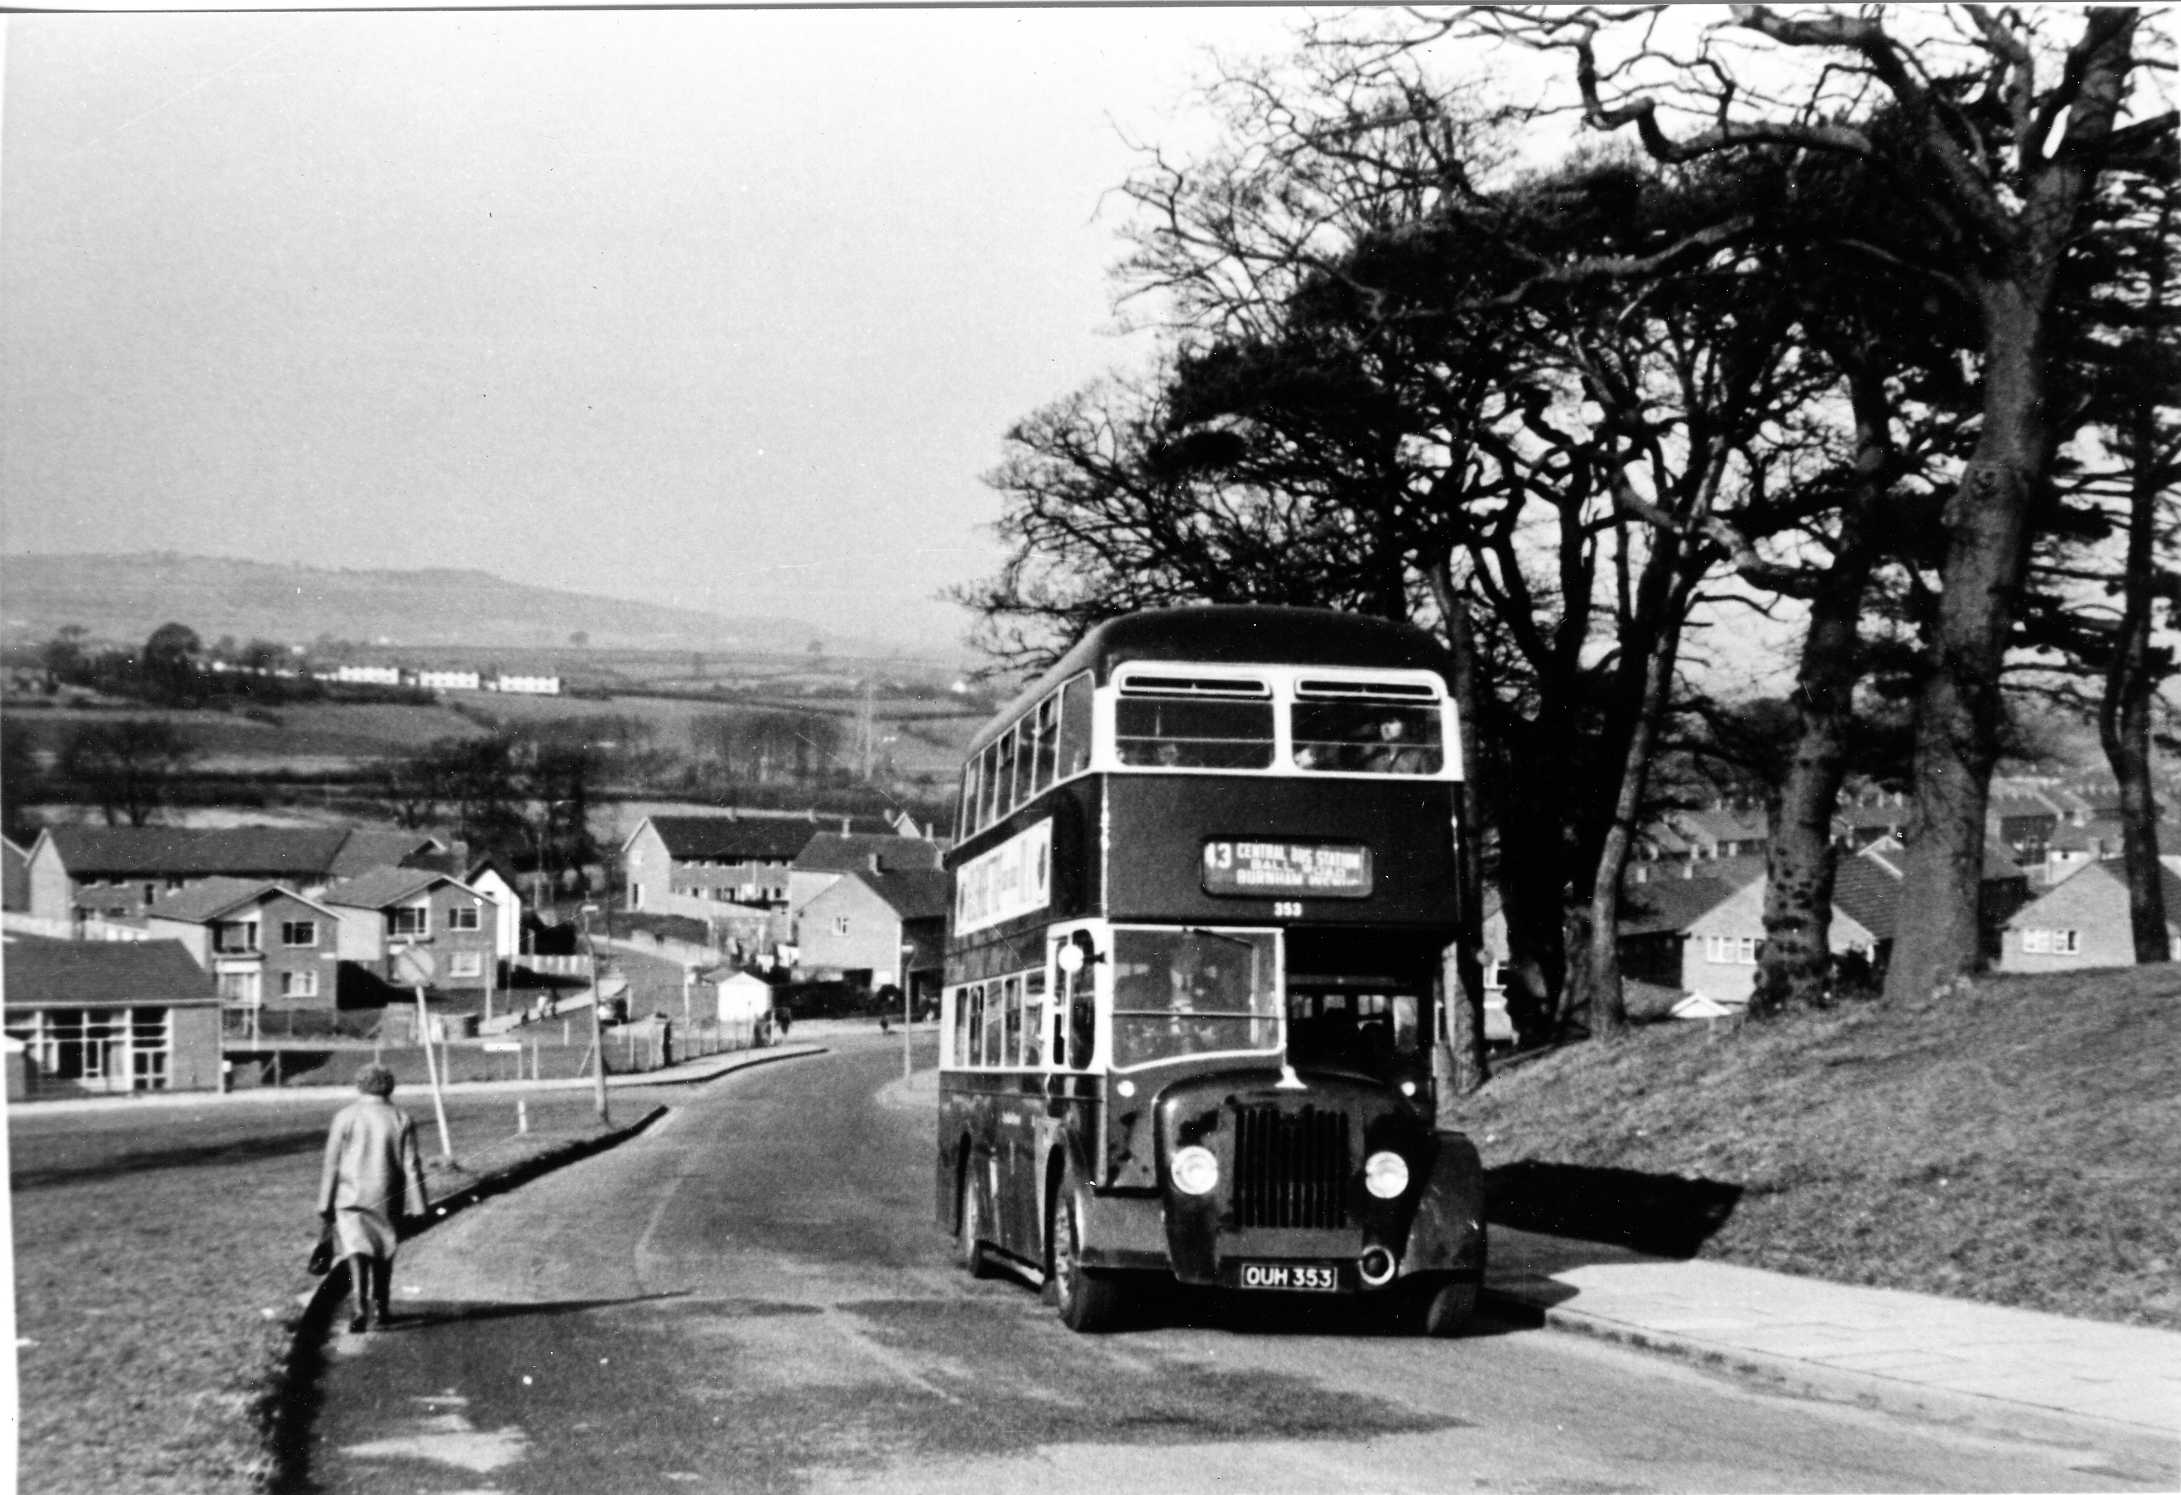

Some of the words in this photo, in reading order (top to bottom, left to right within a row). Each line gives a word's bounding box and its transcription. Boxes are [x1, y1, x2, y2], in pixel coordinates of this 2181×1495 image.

[1236, 843, 1286, 860] CENTRAL
[1274, 902, 1302, 917] 353
[1246, 1267, 1288, 1285] OUH
[1293, 1268, 1332, 1287] 353
